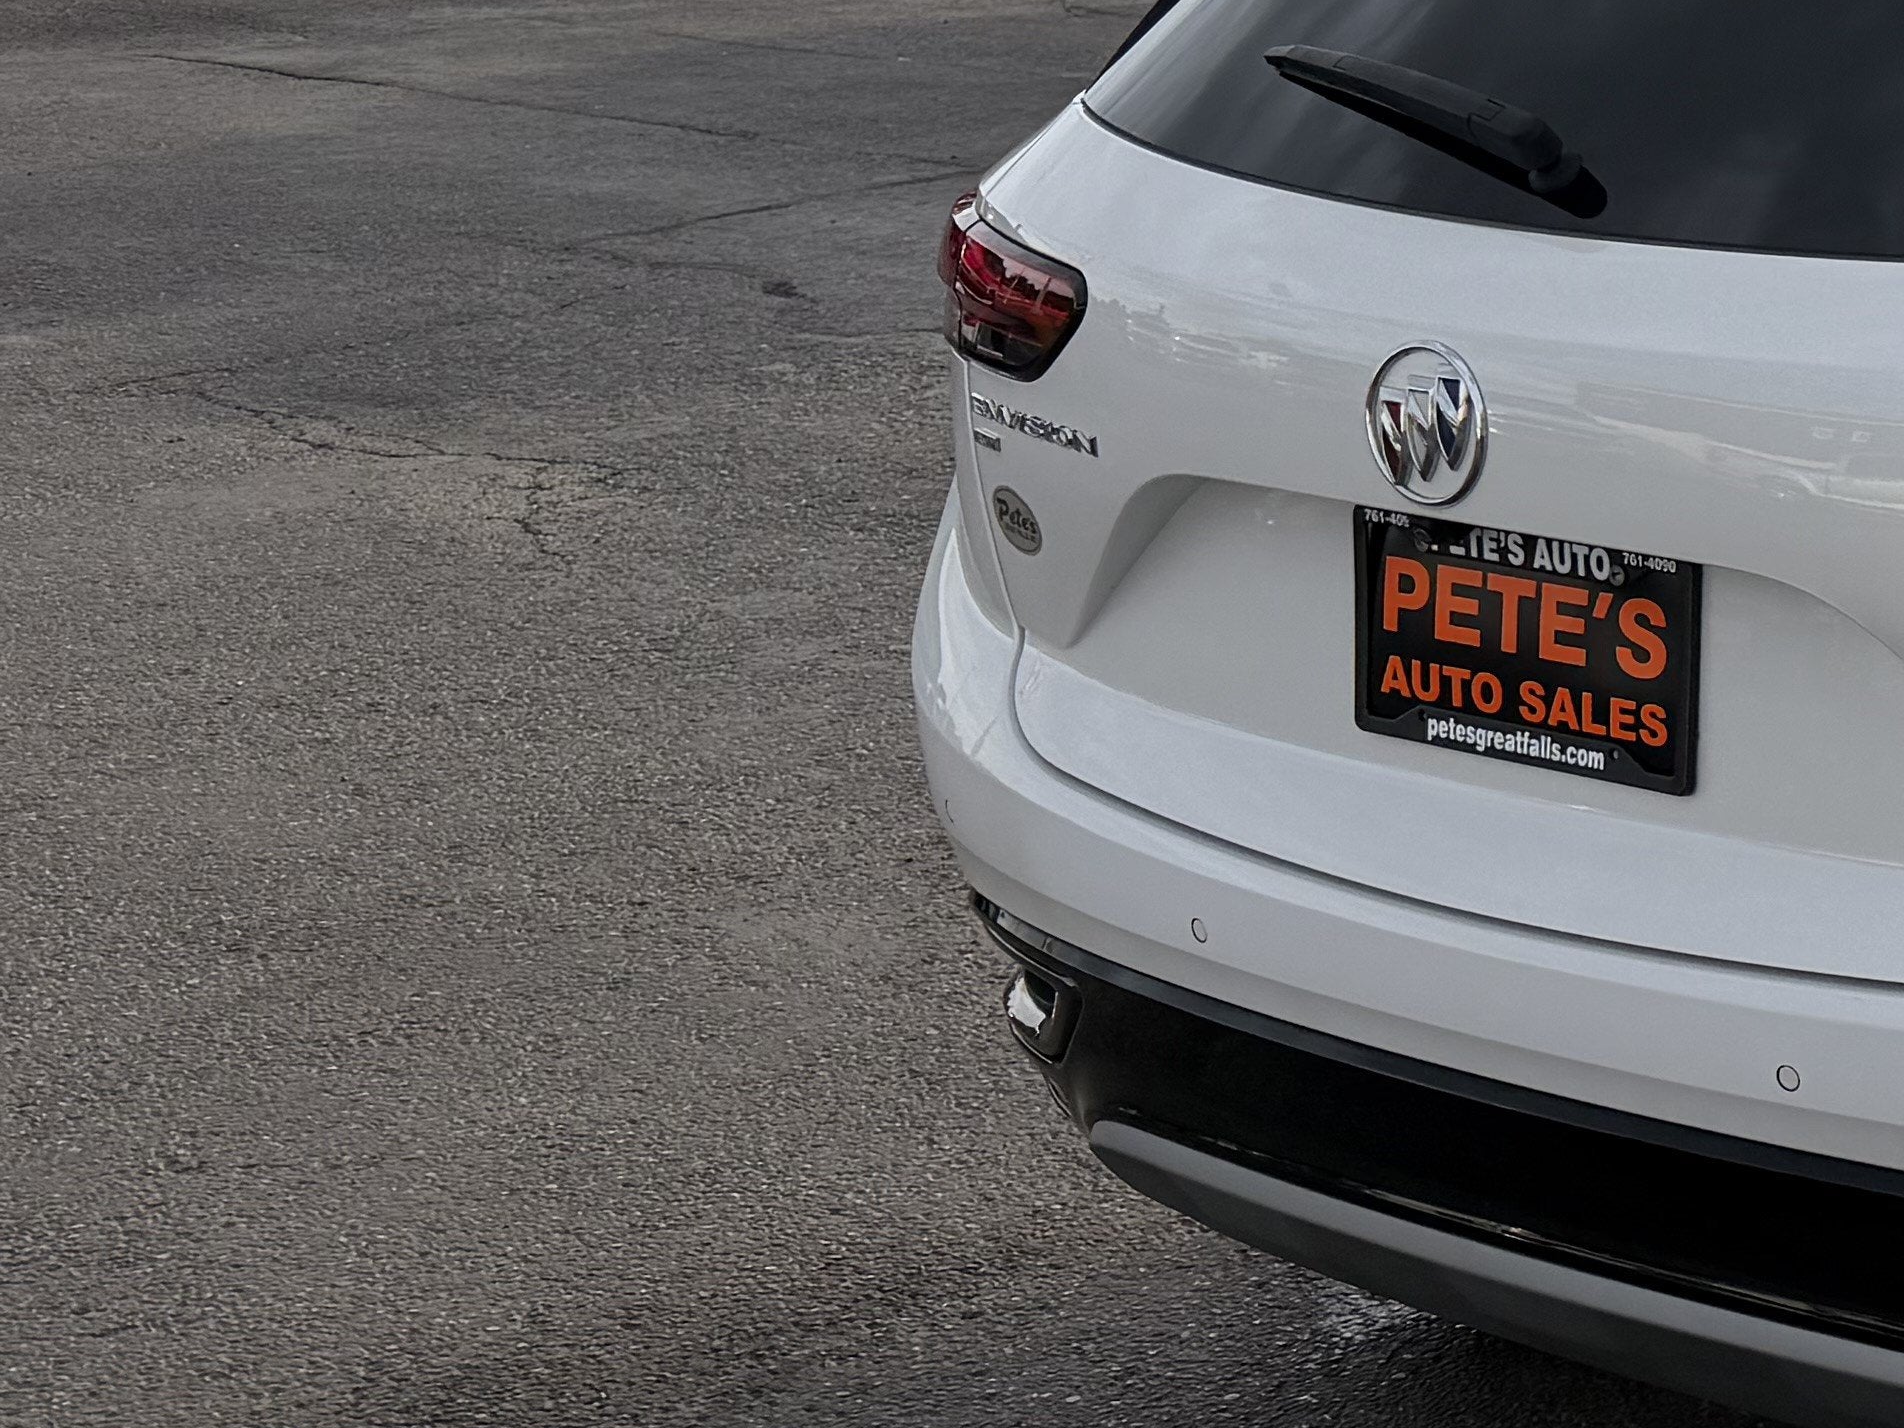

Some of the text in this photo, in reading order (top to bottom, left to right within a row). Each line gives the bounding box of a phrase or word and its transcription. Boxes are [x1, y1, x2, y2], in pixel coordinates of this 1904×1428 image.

[1533, 537, 1610, 581] AUTO
[1622, 551, 1677, 573] 761-4090
[1382, 555, 1668, 680] PETE'S
[1381, 655, 1669, 748] AUTO SALES
[1427, 716, 1605, 771] petesgreatfalls.com
